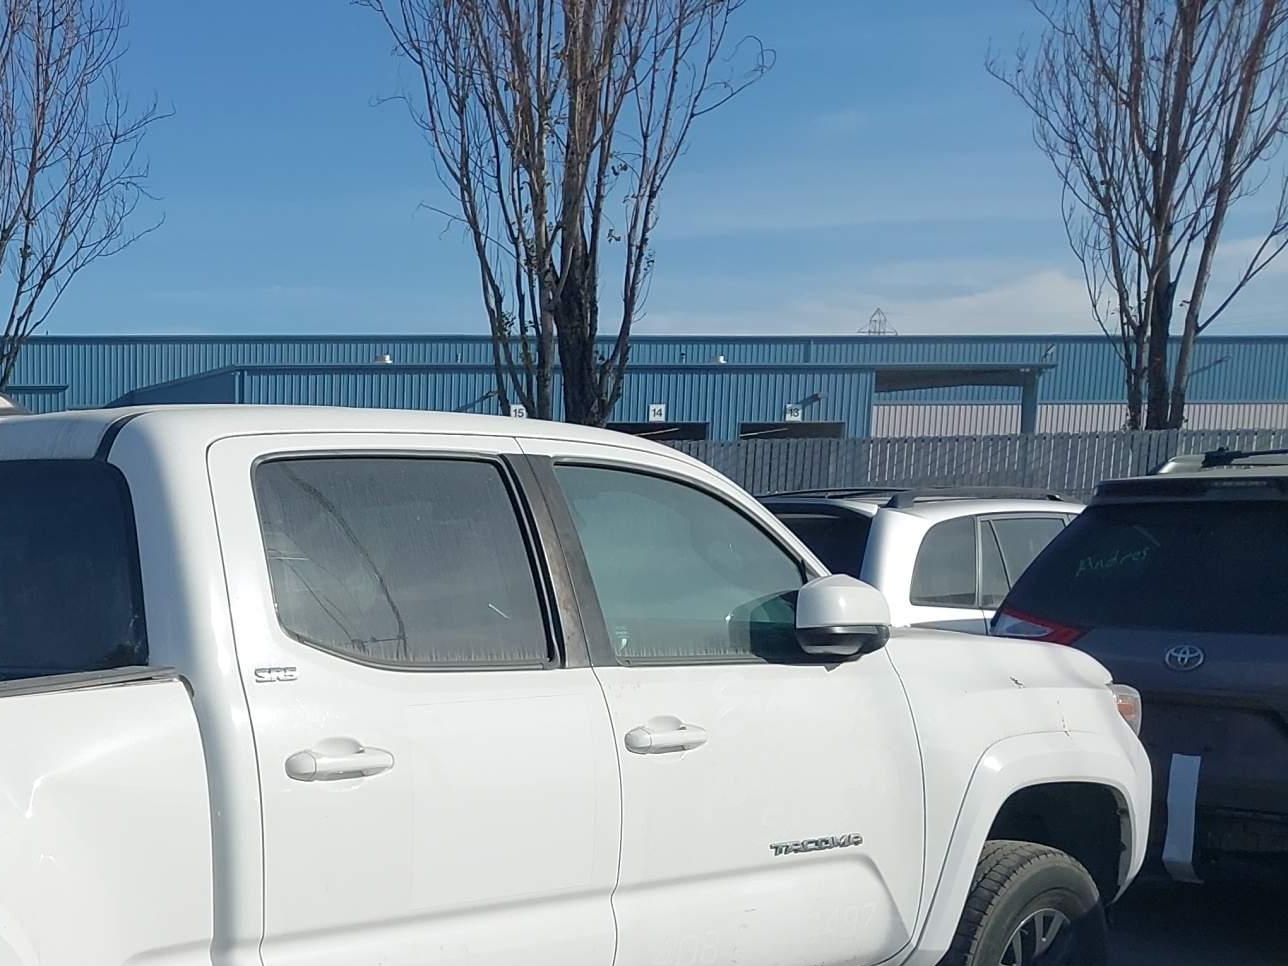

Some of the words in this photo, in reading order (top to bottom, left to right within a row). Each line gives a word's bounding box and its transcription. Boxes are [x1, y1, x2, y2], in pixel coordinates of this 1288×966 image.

[512, 407, 525, 418] 15
[651, 407, 663, 417] 14
[788, 407, 800, 418] 13
[254, 666, 298, 683] SR5
[769, 832, 864, 857] TACOMA
